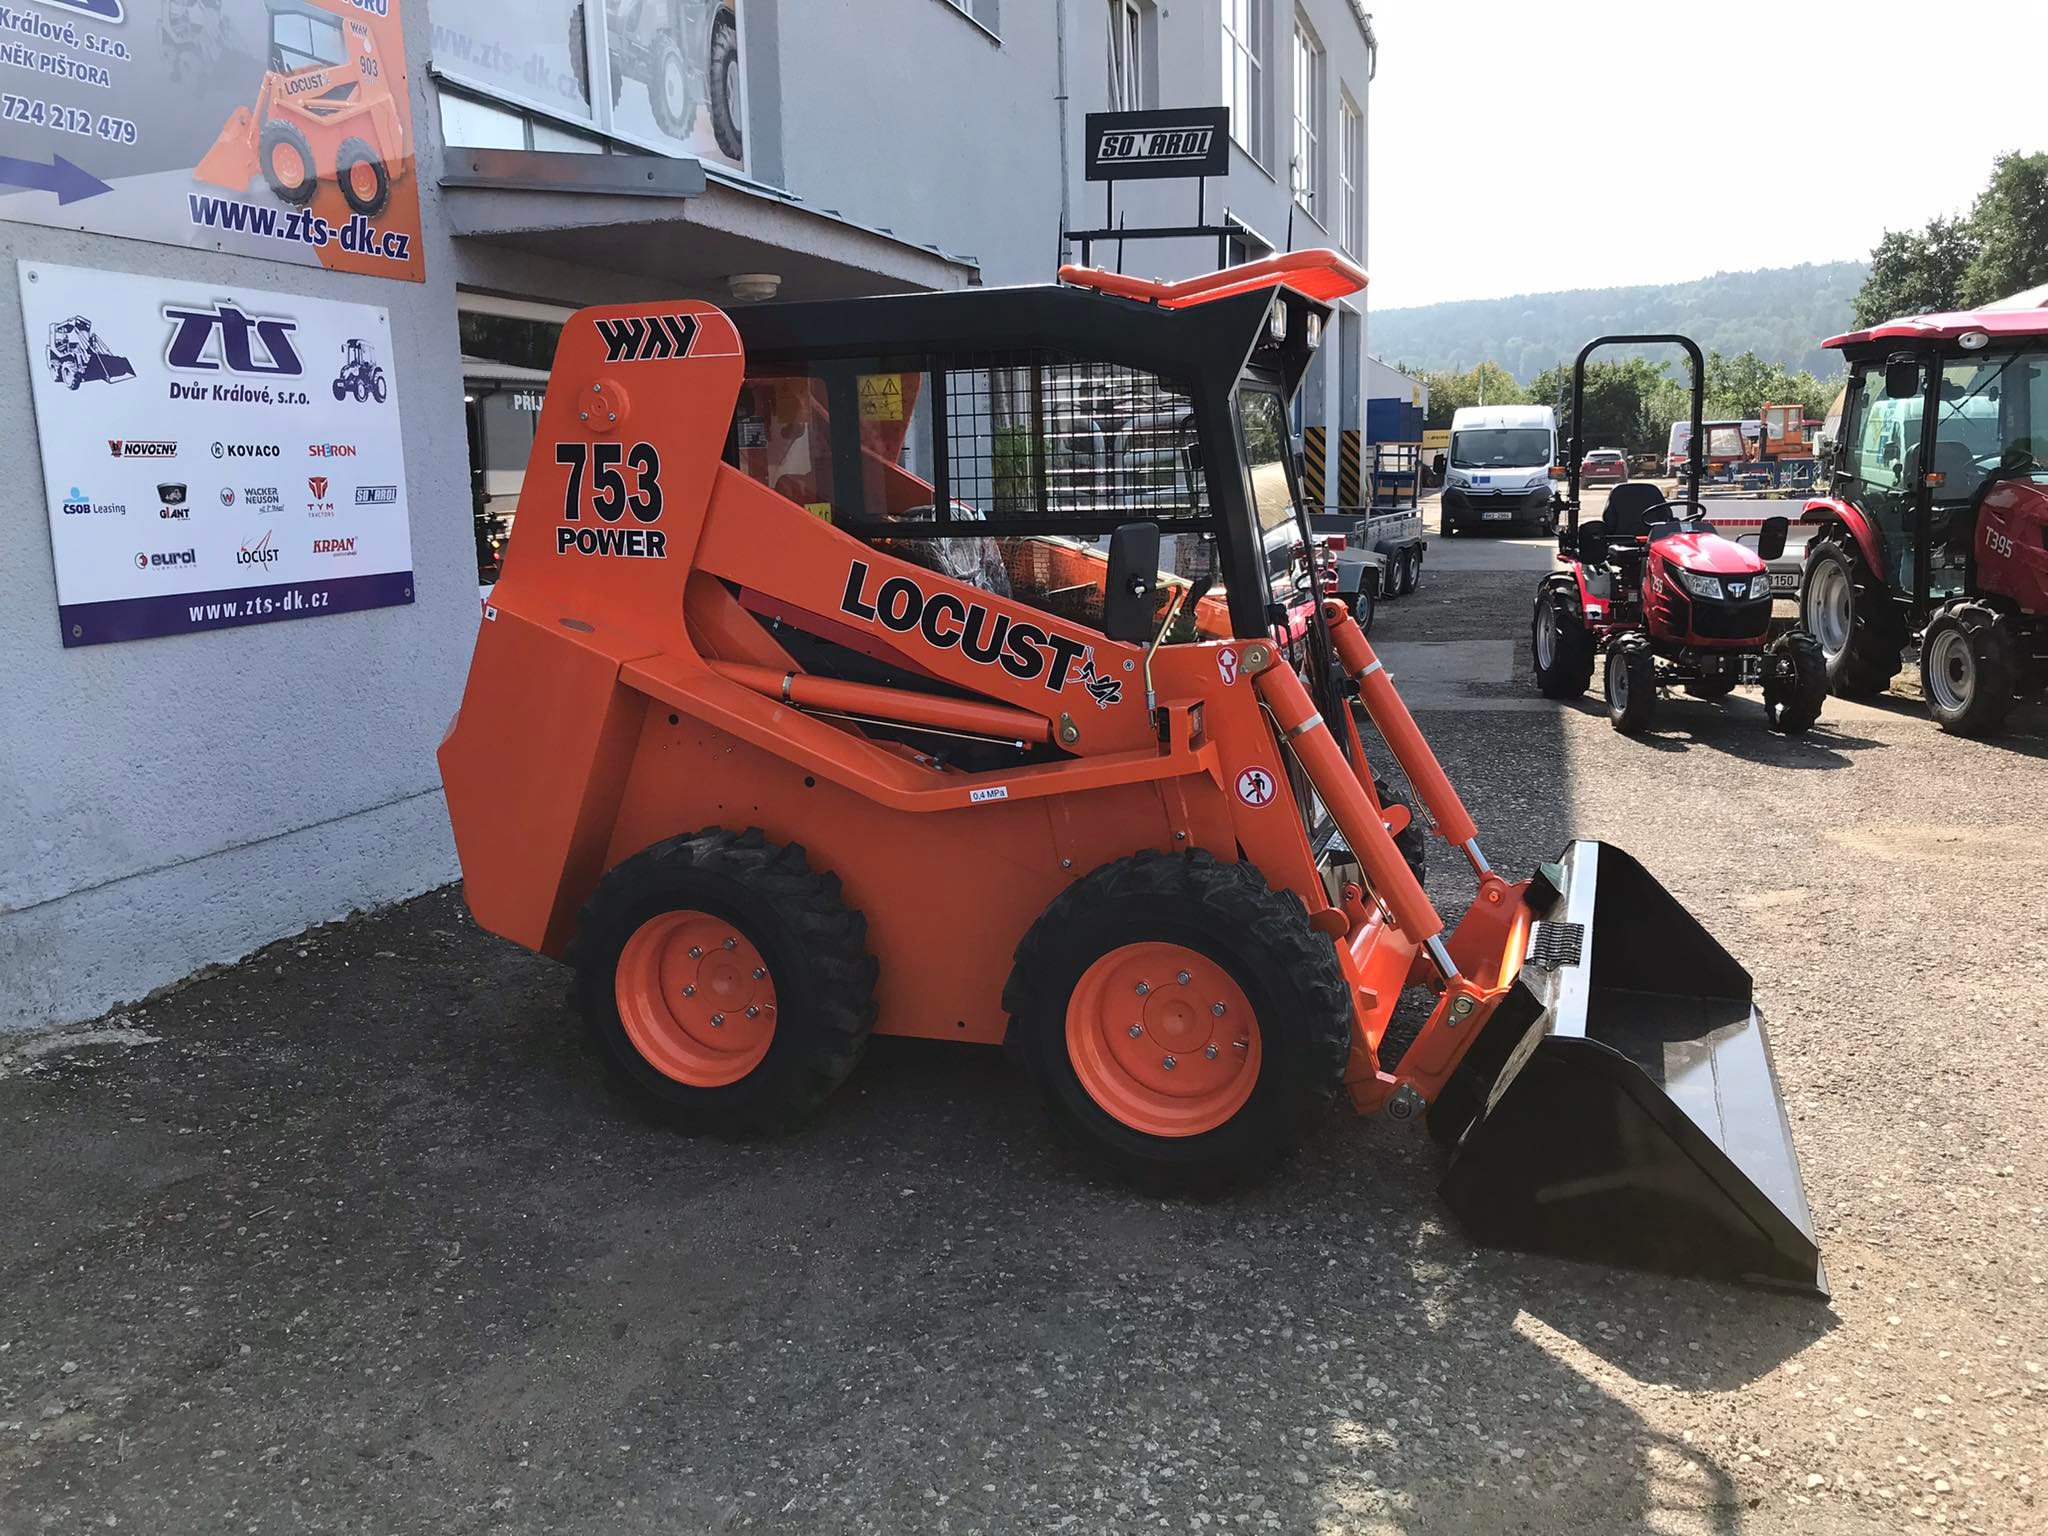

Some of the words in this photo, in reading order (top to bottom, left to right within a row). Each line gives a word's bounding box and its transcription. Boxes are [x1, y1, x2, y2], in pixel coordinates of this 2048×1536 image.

[85, 34, 130, 60] s.r.o.
[39, 53, 110, 87] PIŠTORA
[359, 55, 378, 77] 903
[284, 74, 324, 95] LOCUST
[3, 95, 45, 124] 724
[51, 105, 91, 134] 212
[97, 117, 137, 143] 479
[1099, 129, 1212, 160] SONAROL
[188, 194, 410, 260] www.zts-dk.cz
[593, 313, 703, 363] WAY
[169, 381, 208, 401] Dvůr
[212, 384, 273, 405] Králové,
[277, 391, 310, 405] s.r.o.
[227, 445, 281, 457] KOVACO
[308, 443, 356, 458] SHERON
[244, 487, 278, 496] WACKER
[555, 441, 665, 524] 753
[245, 495, 279, 505] NEUSON
[355, 488, 397, 502] SONAROL
[63, 503, 91, 515] ČSOB
[93, 502, 126, 516] Leasing
[159, 506, 190, 519] GIANT
[307, 503, 334, 511] TYM
[313, 537, 356, 554] KRPAN
[556, 526, 668, 559] POWER
[1985, 526, 2014, 559] T395
[151, 548, 197, 567] eurol
[236, 548, 280, 564] LOCUST
[189, 589, 329, 622] www.zts-dk.cz
[839, 558, 1086, 694] LOCUST
[987, 788, 1006, 799] MPa
